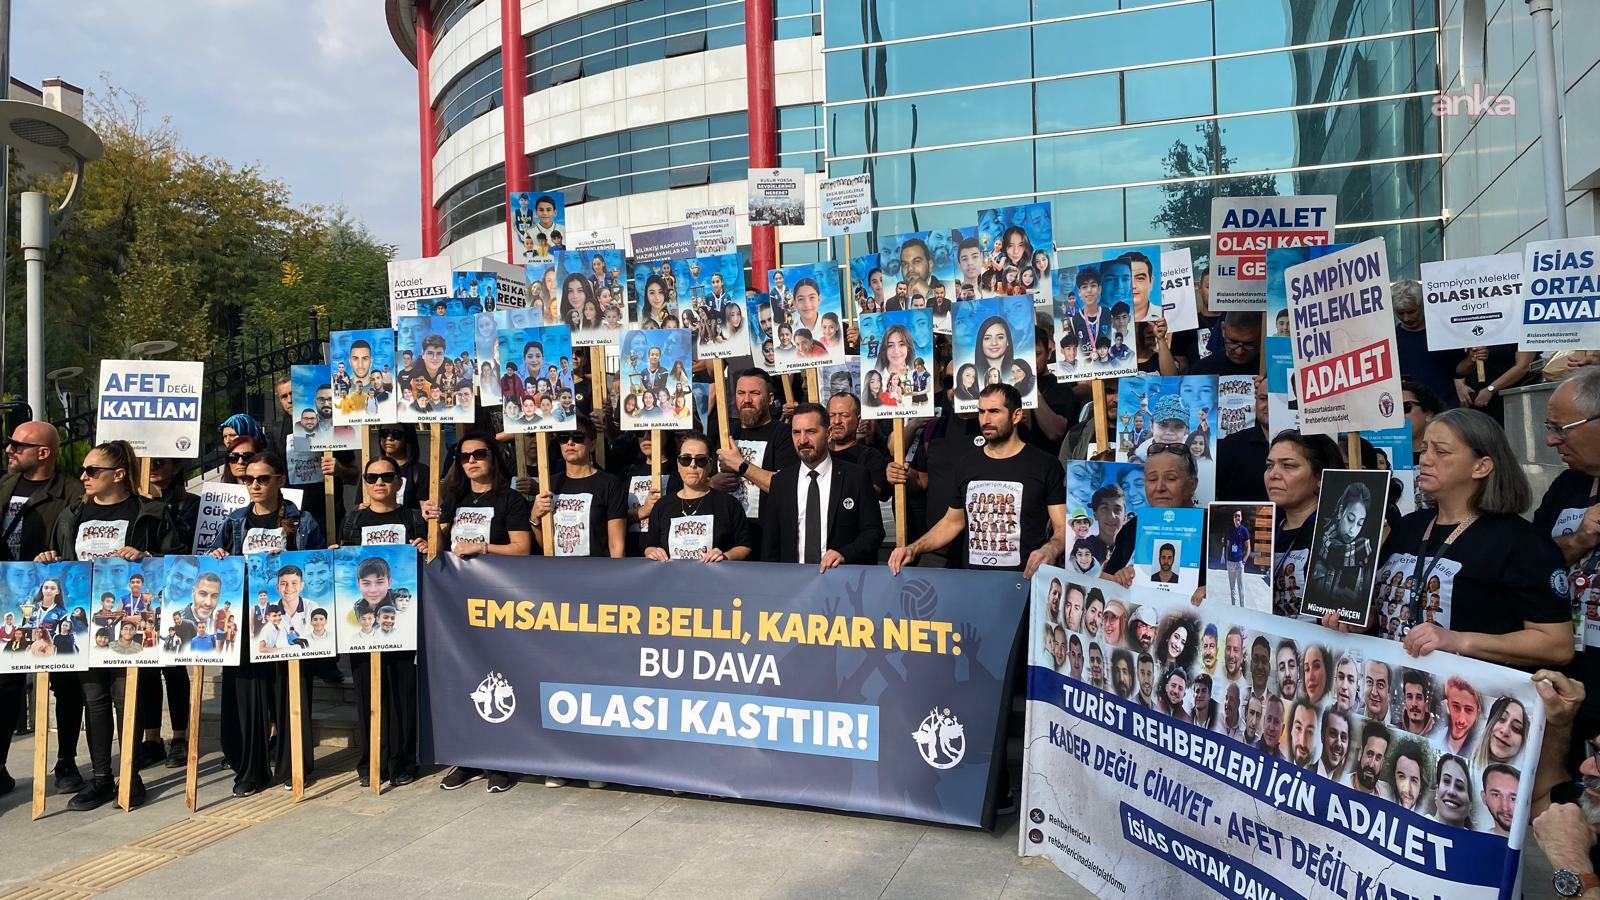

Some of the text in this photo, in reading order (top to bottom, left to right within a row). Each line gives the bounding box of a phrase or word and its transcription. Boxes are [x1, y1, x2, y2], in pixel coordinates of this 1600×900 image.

[1222, 208, 1327, 228] ADALET
[660, 240, 691, 250] RAPORUNU
[1218, 236, 1326, 251] OLASI KAST
[1218, 265, 1236, 276] İLE
[1533, 249, 1594, 273] İSİAS
[394, 278, 423, 288] Adalet
[1160, 267, 1189, 278] elekler
[1291, 252, 1381, 305] ŞAMPİYON
[1427, 272, 1521, 290] Şampiyon Melekler
[395, 286, 447, 299] OLASI KAST
[1427, 283, 1523, 304] OLASI KAST
[1531, 275, 1600, 296] ORTA
[1294, 285, 1384, 330] MELEKLER
[1461, 301, 1489, 312] diyor!
[1529, 300, 1600, 321] DAVA
[1296, 328, 1332, 362] İÇİN
[1094, 368, 1138, 378] TOPUKÇUOĞLU
[1305, 345, 1385, 400] ADALET
[104, 373, 196, 394] AFET DEĞİL
[103, 399, 196, 419] KATLİAM
[205, 492, 246, 504] Birlikte
[203, 506, 237, 520] Güçl
[467, 597, 961, 656] EMSALLER BELLİ, KARAR NET:
[639, 647, 781, 686] BU DAVA
[549, 690, 868, 750] OLASI KASTTIR!
[1063, 684, 1453, 872] TURİST REHBERLERİ İÇİN ADALET
[1049, 720, 1091, 767] KADER
[1093, 744, 1139, 790] DEĞİL
[1143, 768, 1213, 826] CİNAYET
[1227, 811, 1284, 860] AFET
[1290, 835, 1349, 900] DEĞİL
[1048, 813, 1092, 846] RehberlericinA
[1127, 812, 1169, 854] İSİAS
[1171, 841, 1231, 888] ORTAK
[1047, 835, 1128, 894] rehberlericinadaletplatformu
